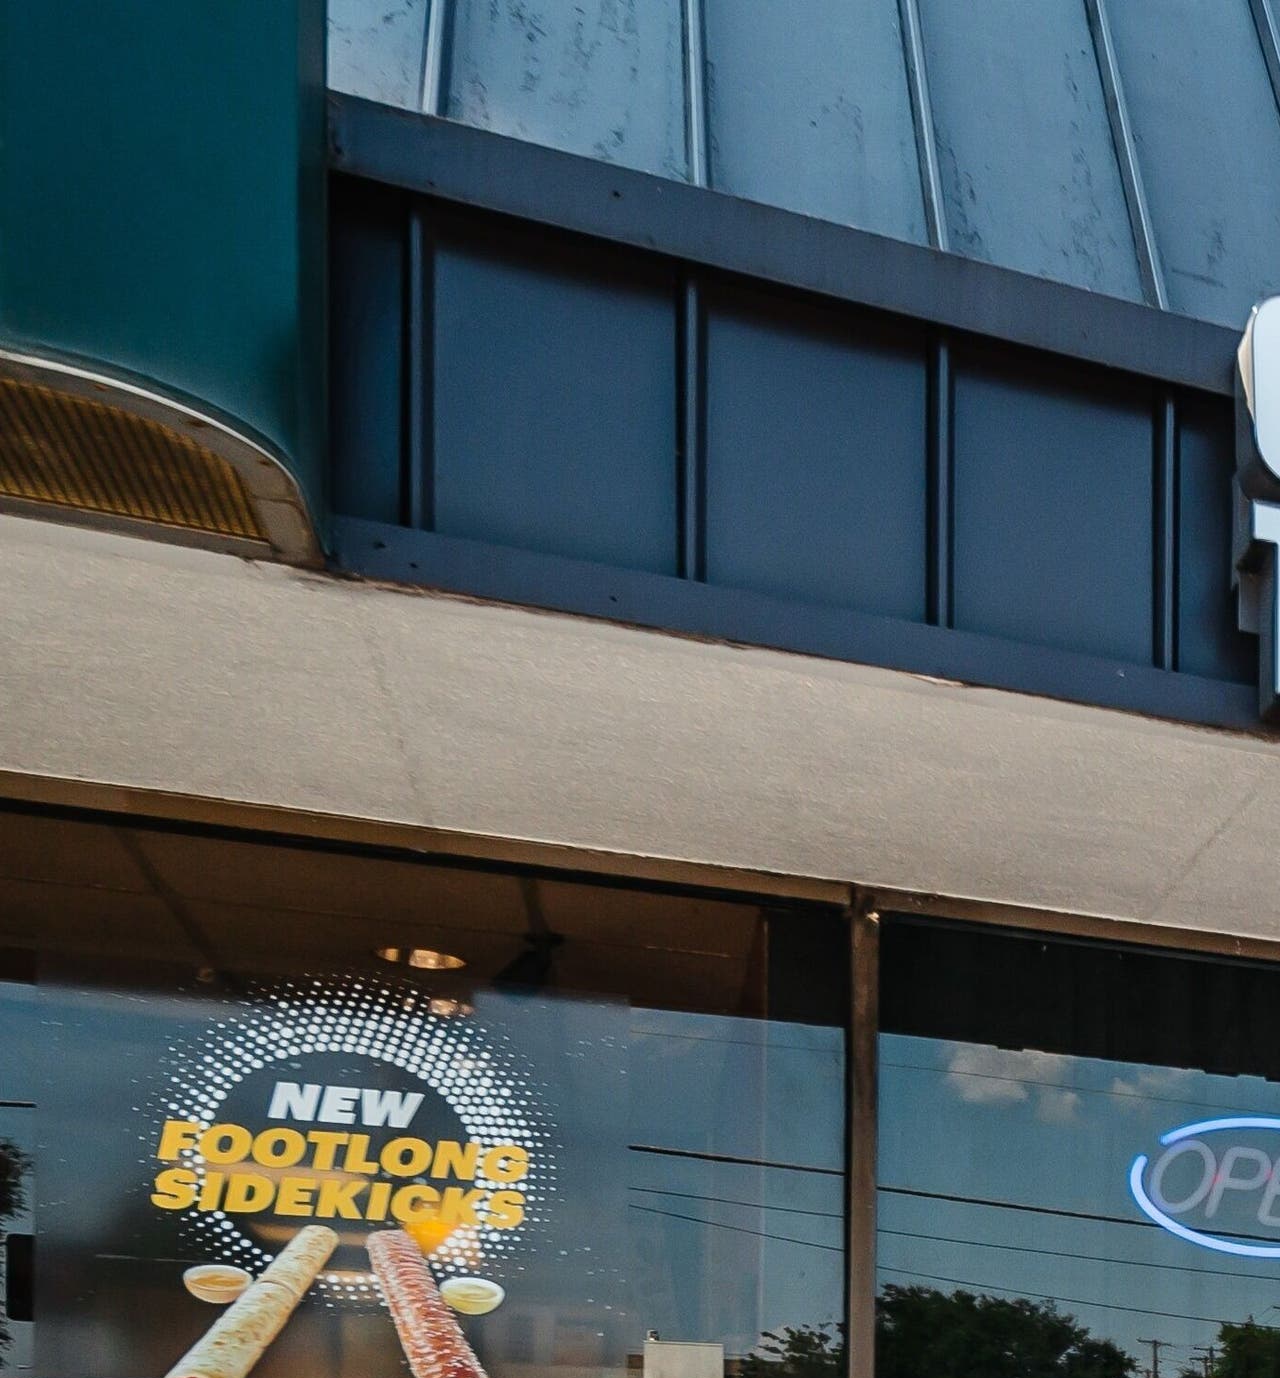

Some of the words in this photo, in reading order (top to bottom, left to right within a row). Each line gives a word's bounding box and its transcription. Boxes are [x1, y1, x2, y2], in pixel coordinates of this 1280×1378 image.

[267, 1081, 425, 1129] NEW
[157, 1120, 529, 1184] FOOTLONG
[151, 1167, 527, 1230] SIDEKICKS
